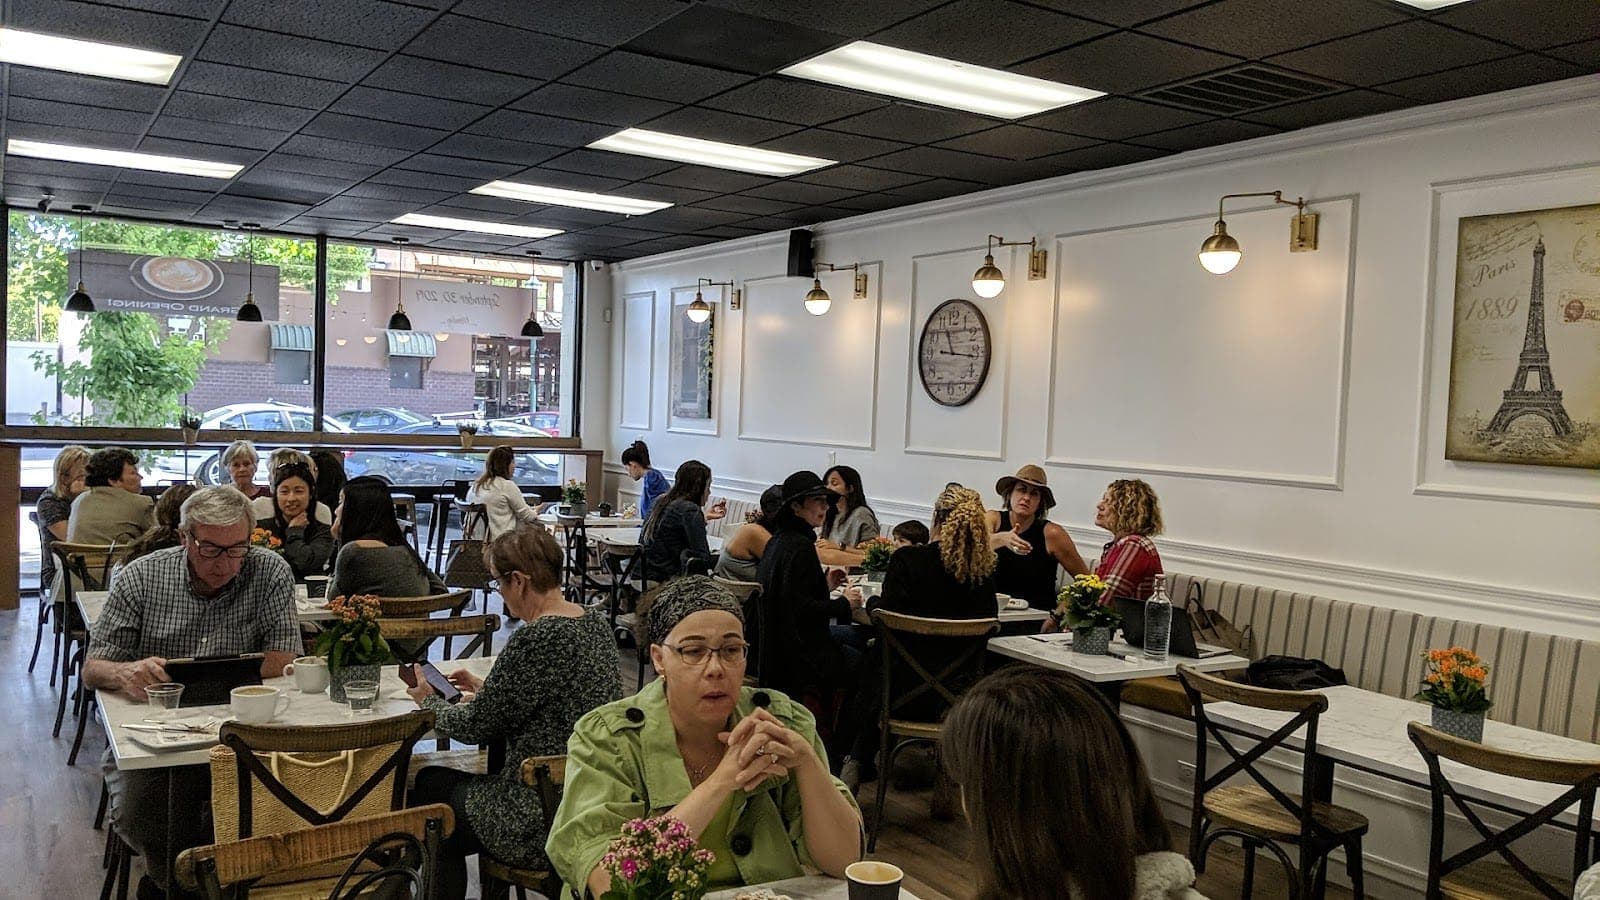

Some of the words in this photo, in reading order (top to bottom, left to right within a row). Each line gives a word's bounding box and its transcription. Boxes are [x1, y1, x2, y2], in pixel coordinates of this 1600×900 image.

[1472, 260, 1516, 288] Paris
[1465, 296, 1518, 321] 1889
[949, 310, 960, 326] 12
[969, 326, 977, 342] 2
[968, 362, 976, 378] 4
